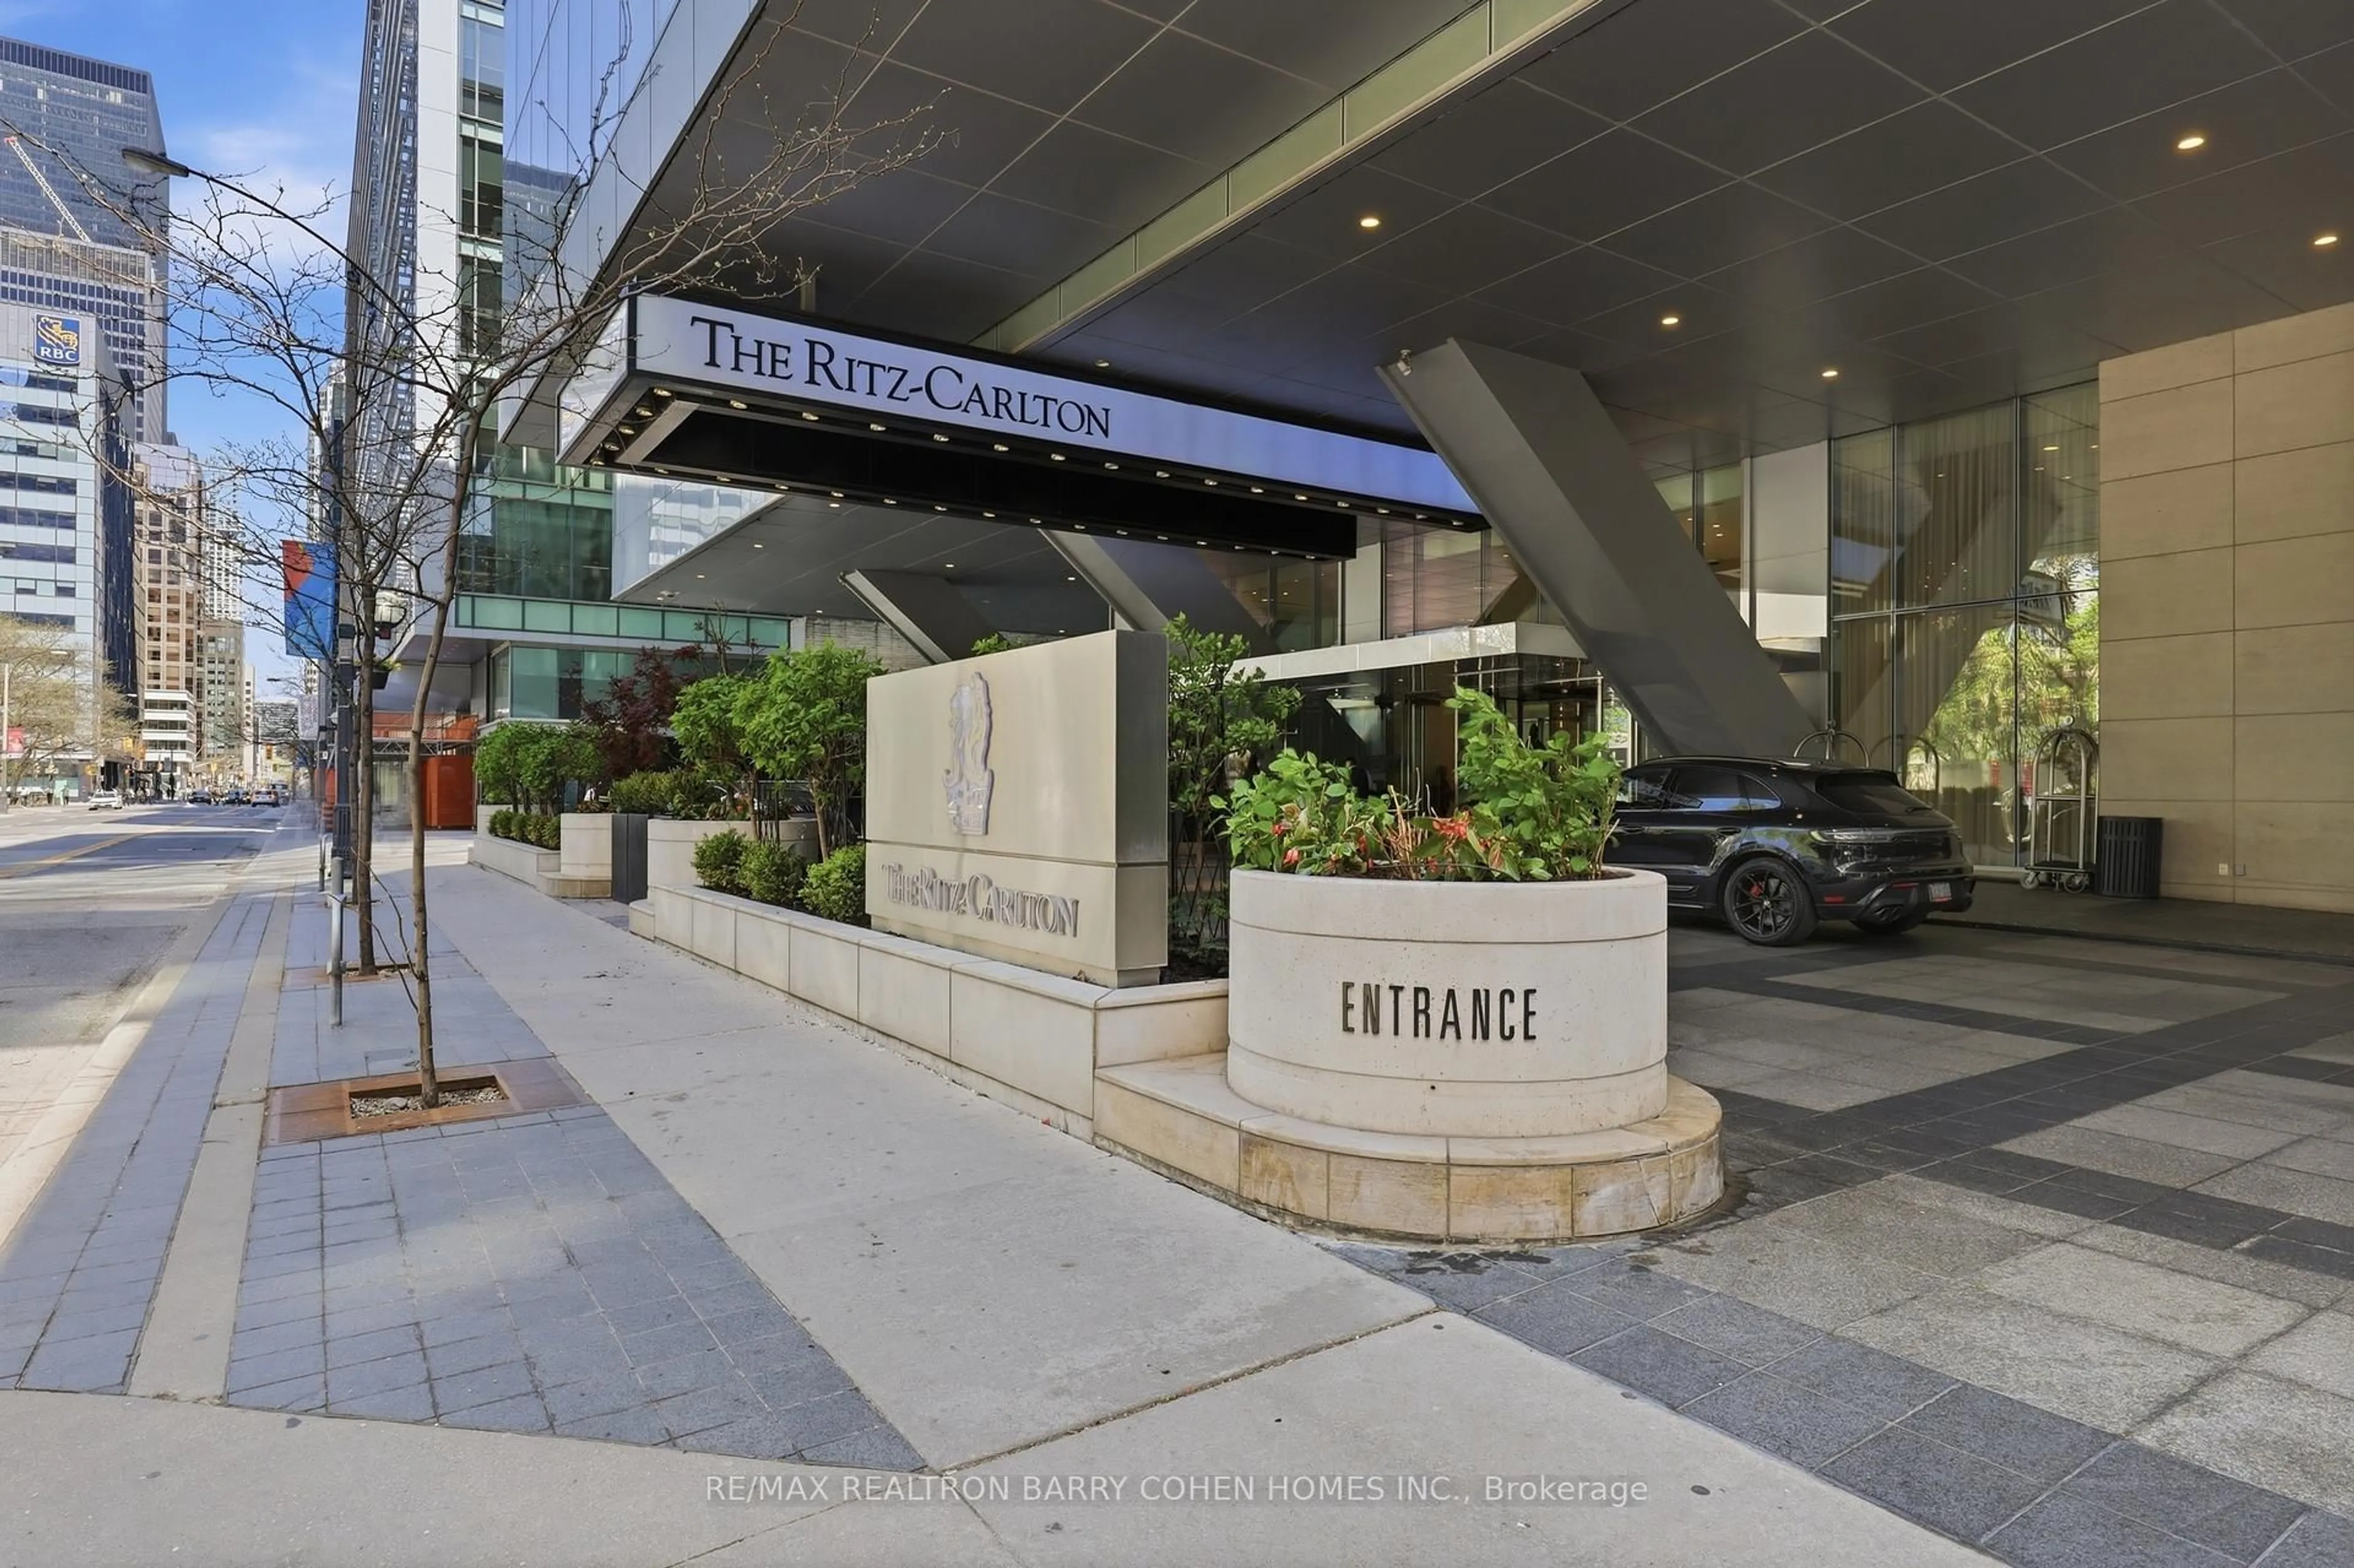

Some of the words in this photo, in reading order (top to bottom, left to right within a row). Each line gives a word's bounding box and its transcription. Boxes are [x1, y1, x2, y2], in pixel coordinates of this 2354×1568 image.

[40, 346, 77, 361] RBC
[690, 316, 793, 381] THE
[804, 338, 1111, 439] RITZ-CARLTON
[882, 863, 919, 906] THE
[1342, 981, 1537, 1041] ENTRANCE
